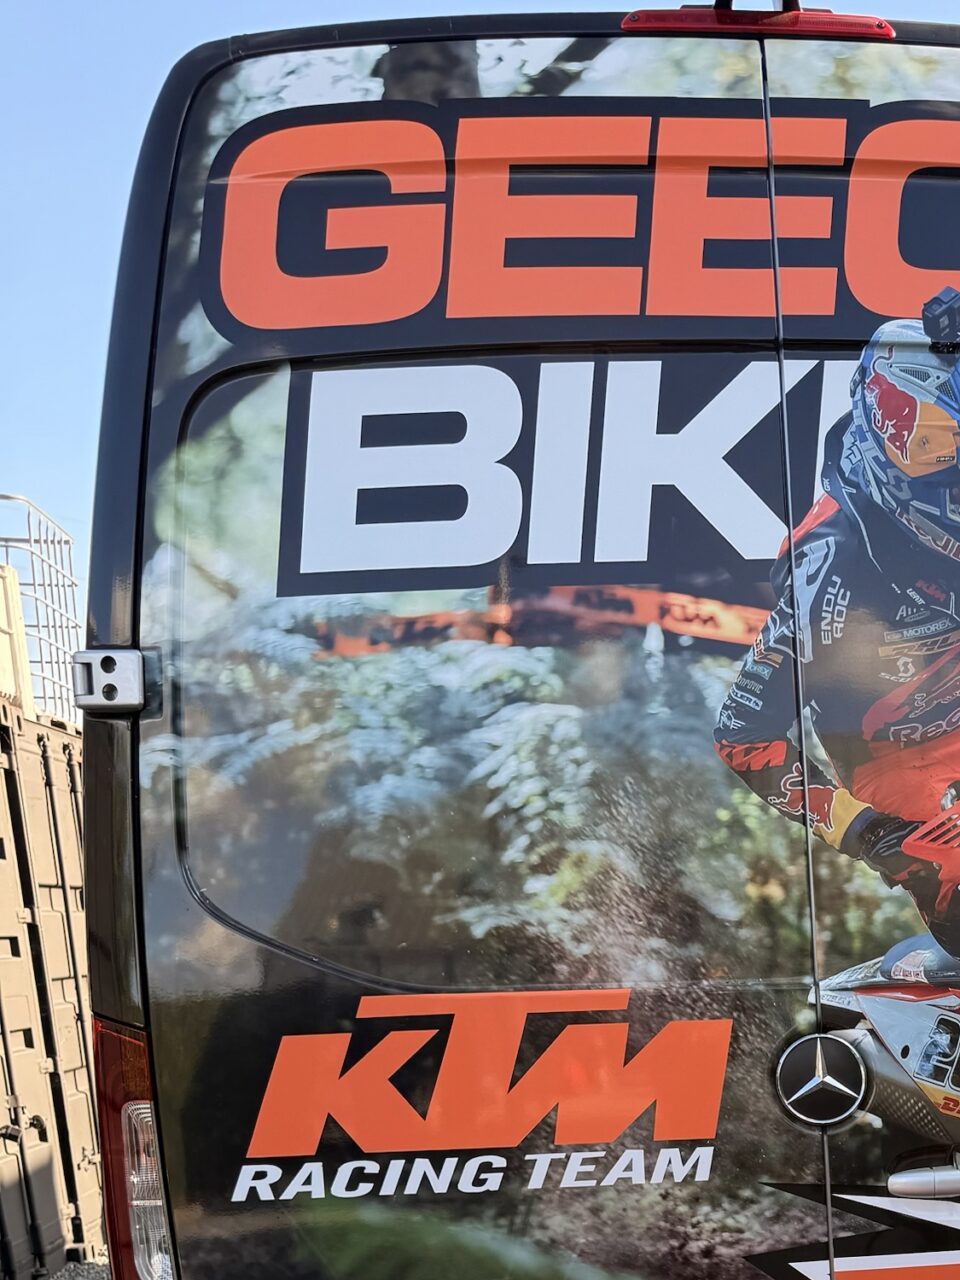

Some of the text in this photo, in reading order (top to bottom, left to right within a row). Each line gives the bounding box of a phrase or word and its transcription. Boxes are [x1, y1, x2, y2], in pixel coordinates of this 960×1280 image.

[903, 618, 952, 639] MOTOREX
[246, 988, 733, 1159] KTM
[231, 1145, 715, 1202] RACING TEAM
